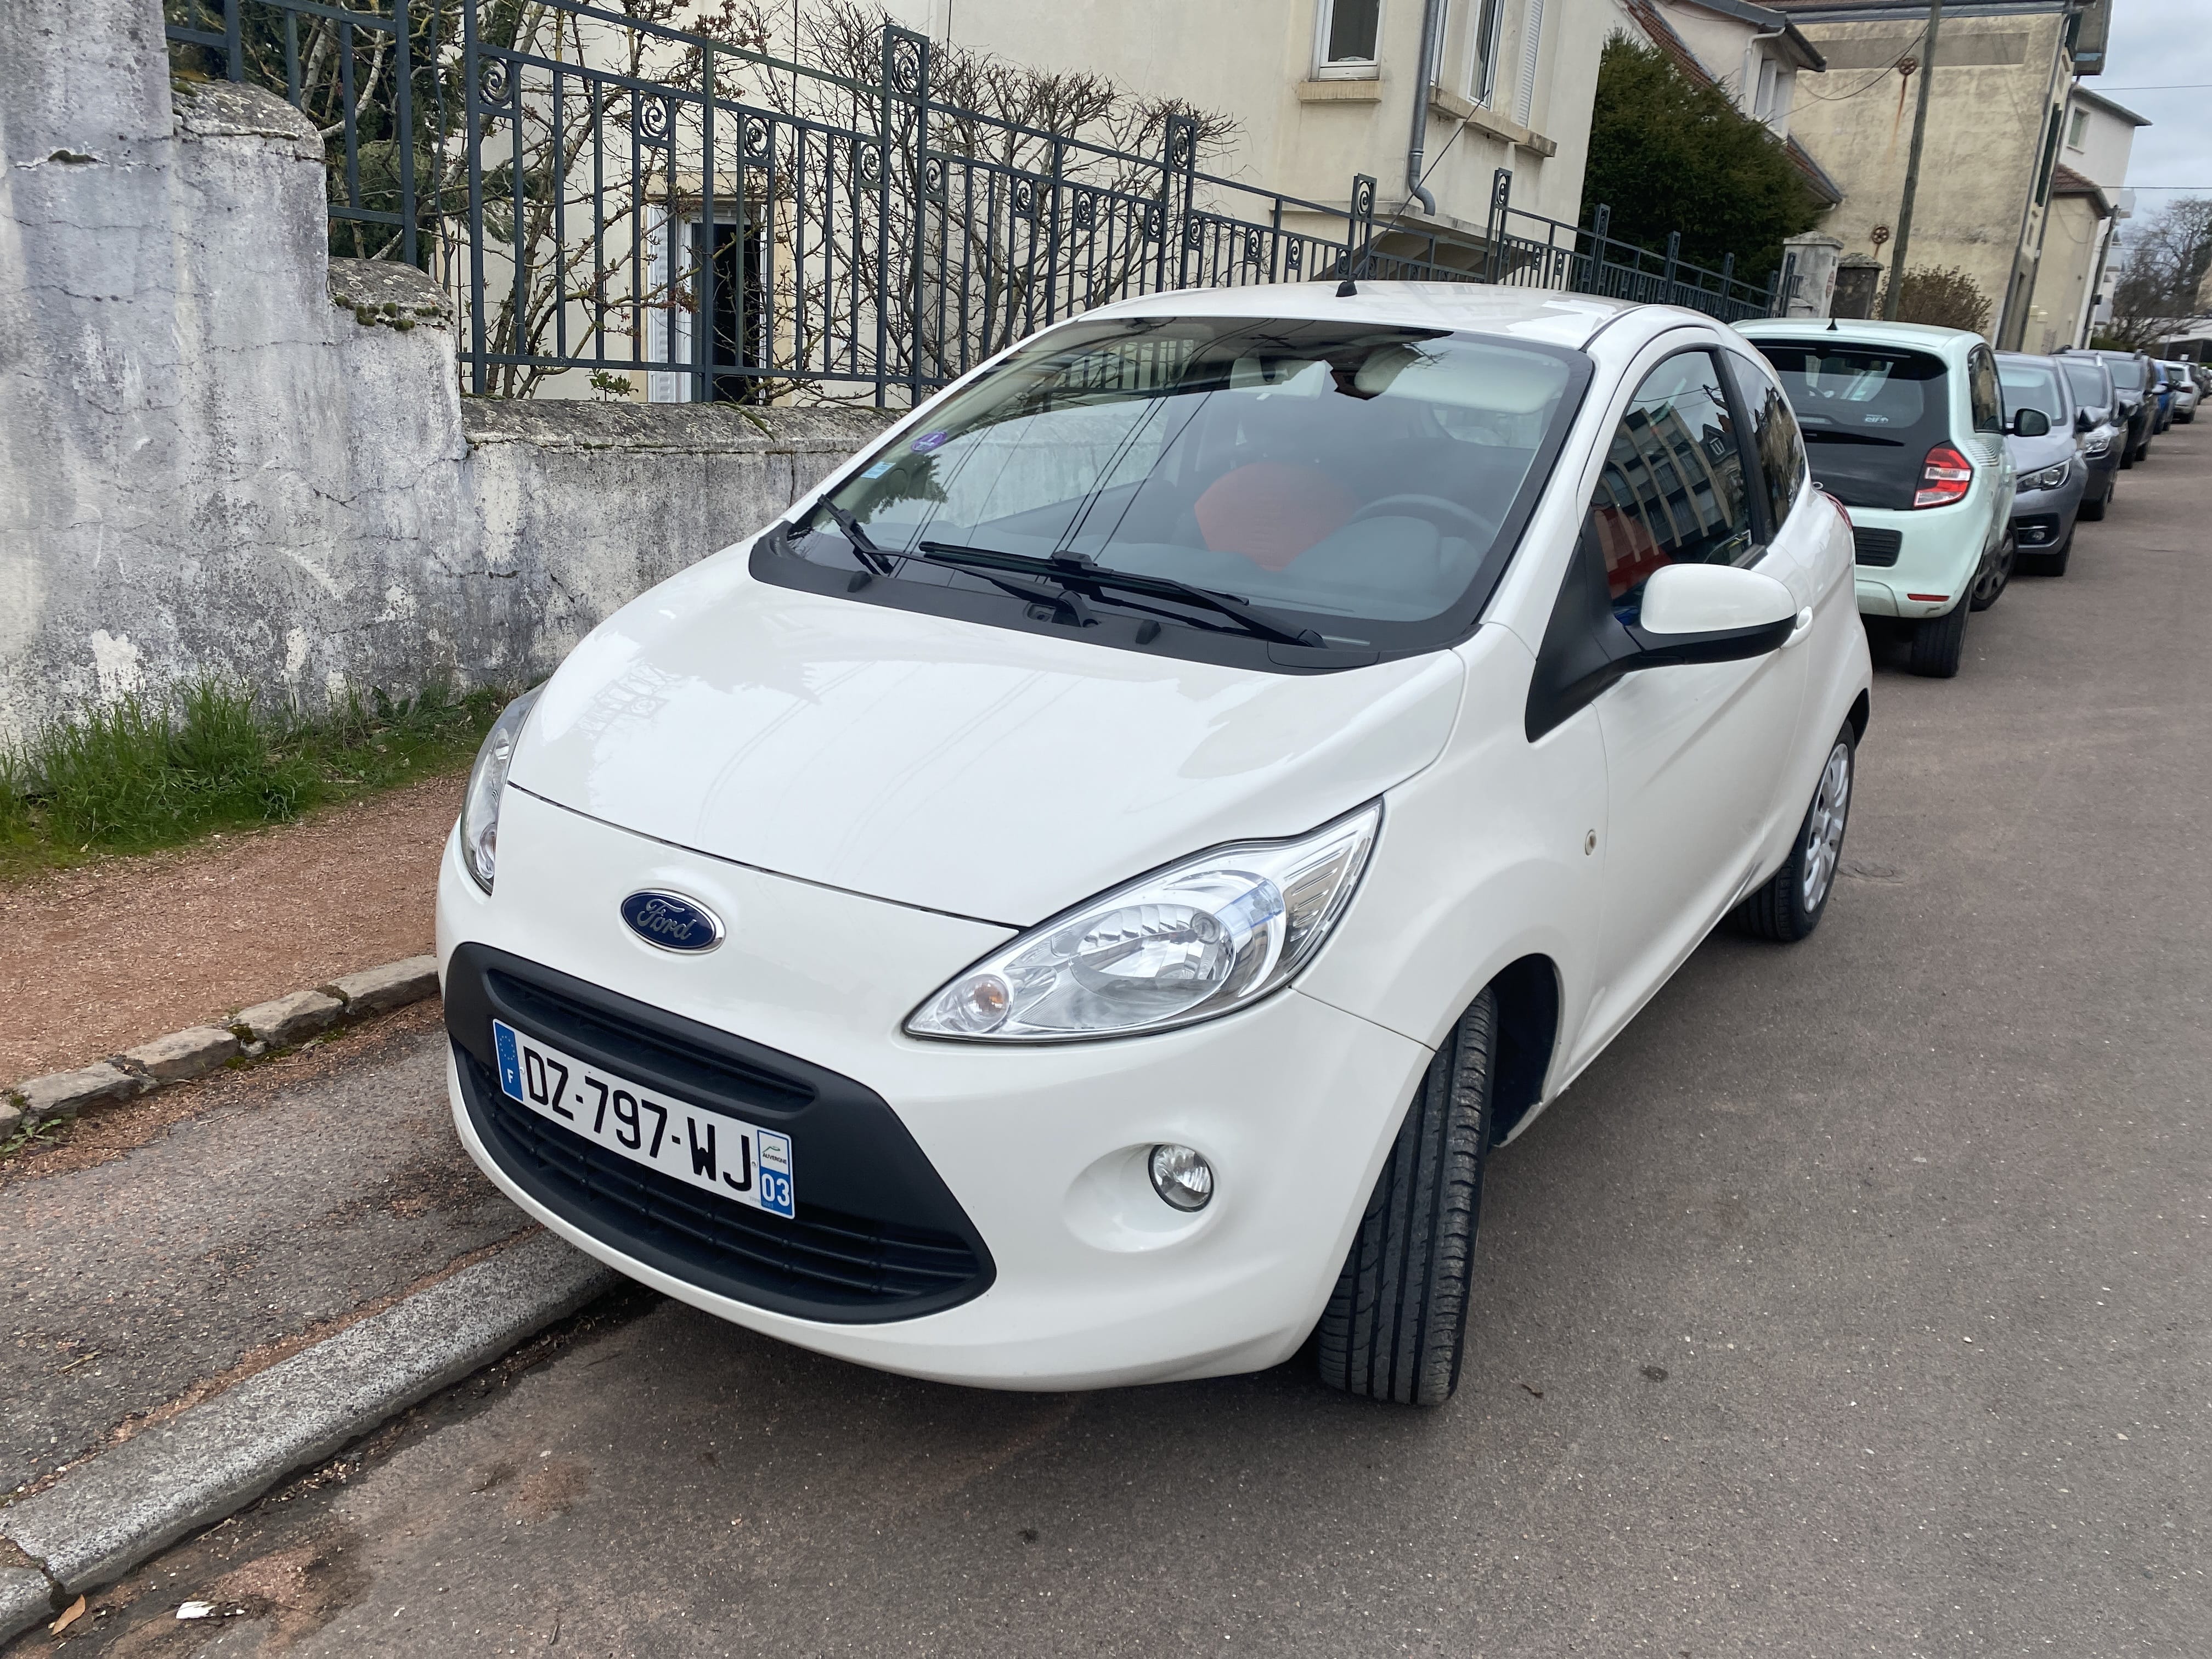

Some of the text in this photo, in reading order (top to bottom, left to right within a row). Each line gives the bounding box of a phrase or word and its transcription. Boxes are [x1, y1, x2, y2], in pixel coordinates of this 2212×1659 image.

[637, 898, 696, 940] Ford
[507, 1068, 514, 1084] F
[523, 1046, 752, 1192] DZ-797-WJ
[763, 1153, 787, 1165] AUVERGNE
[761, 1173, 790, 1206] 03
